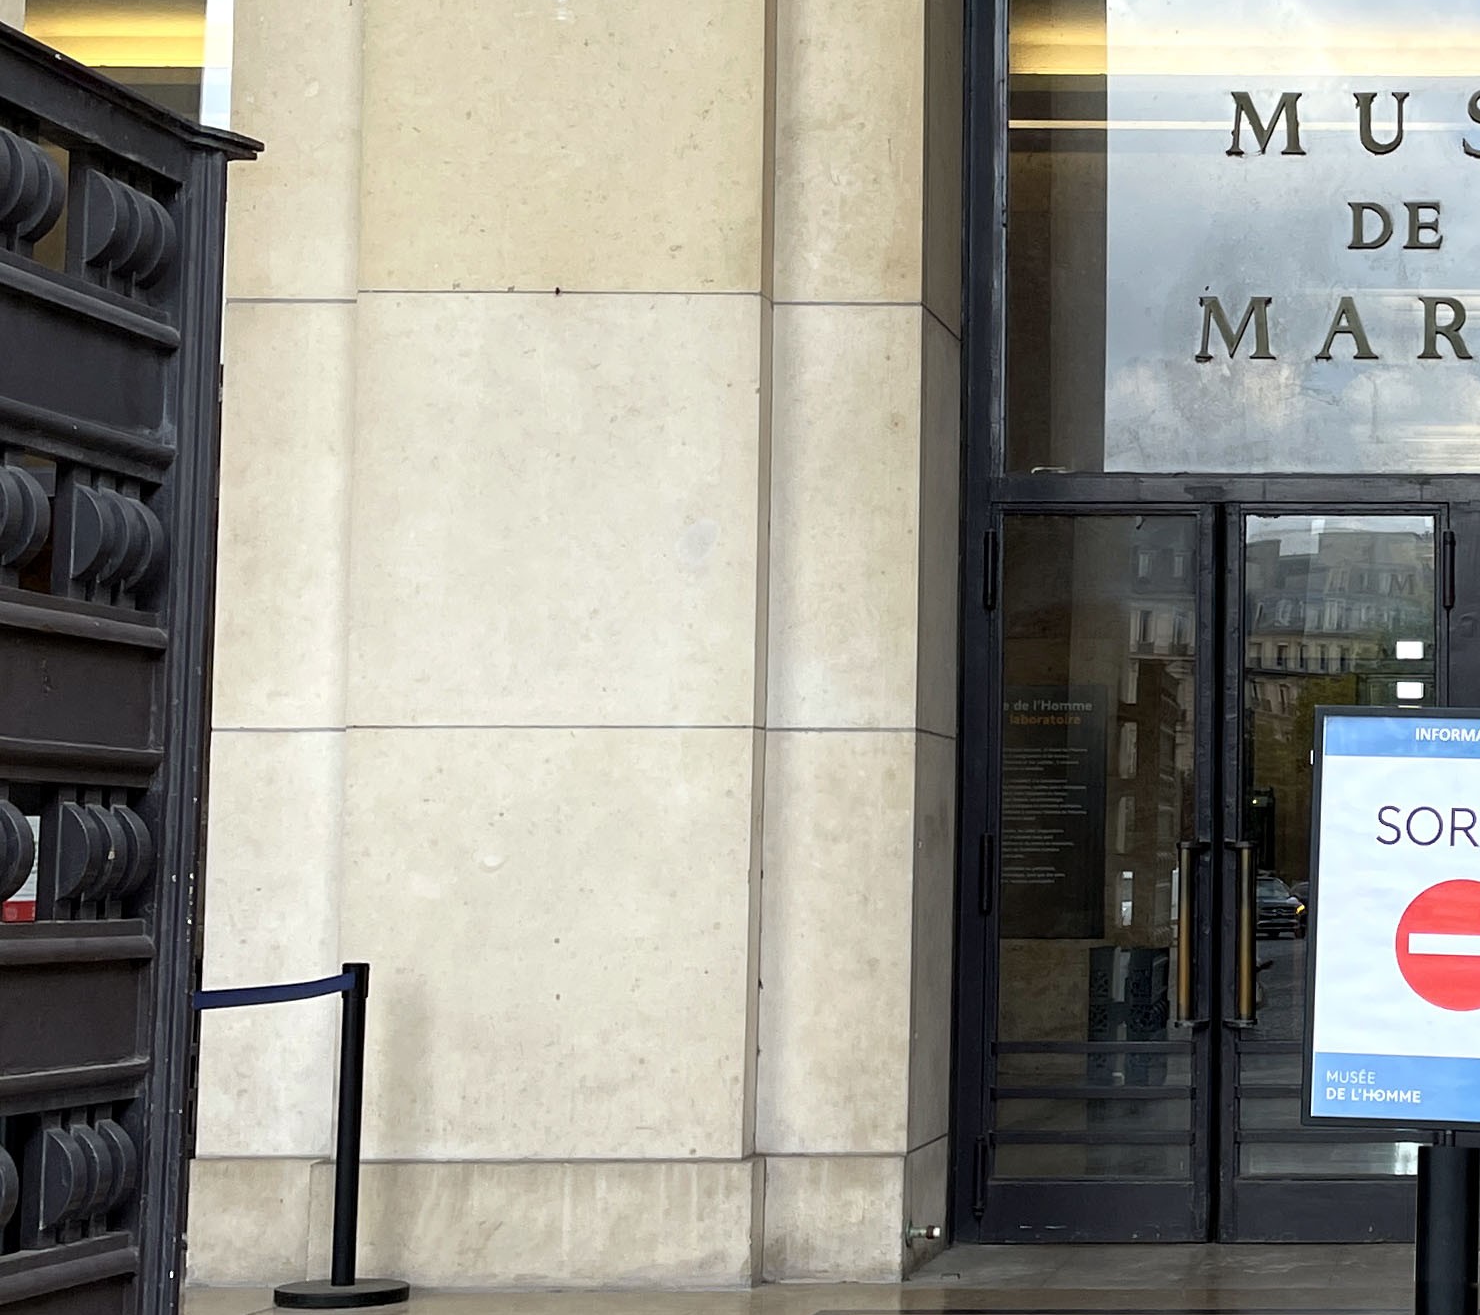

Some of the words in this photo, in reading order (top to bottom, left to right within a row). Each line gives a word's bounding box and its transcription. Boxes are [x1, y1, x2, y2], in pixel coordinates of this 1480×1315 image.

[1347, 201, 1445, 250] DE
[1013, 699, 1029, 712] de
[1033, 699, 1093, 712] l'Homme
[1009, 714, 1082, 726] laboratoire
[1326, 1069, 1376, 1084] MUSÉE
[1326, 1087, 1346, 1100] DE
[1351, 1088, 1422, 1103] L'HOMME
